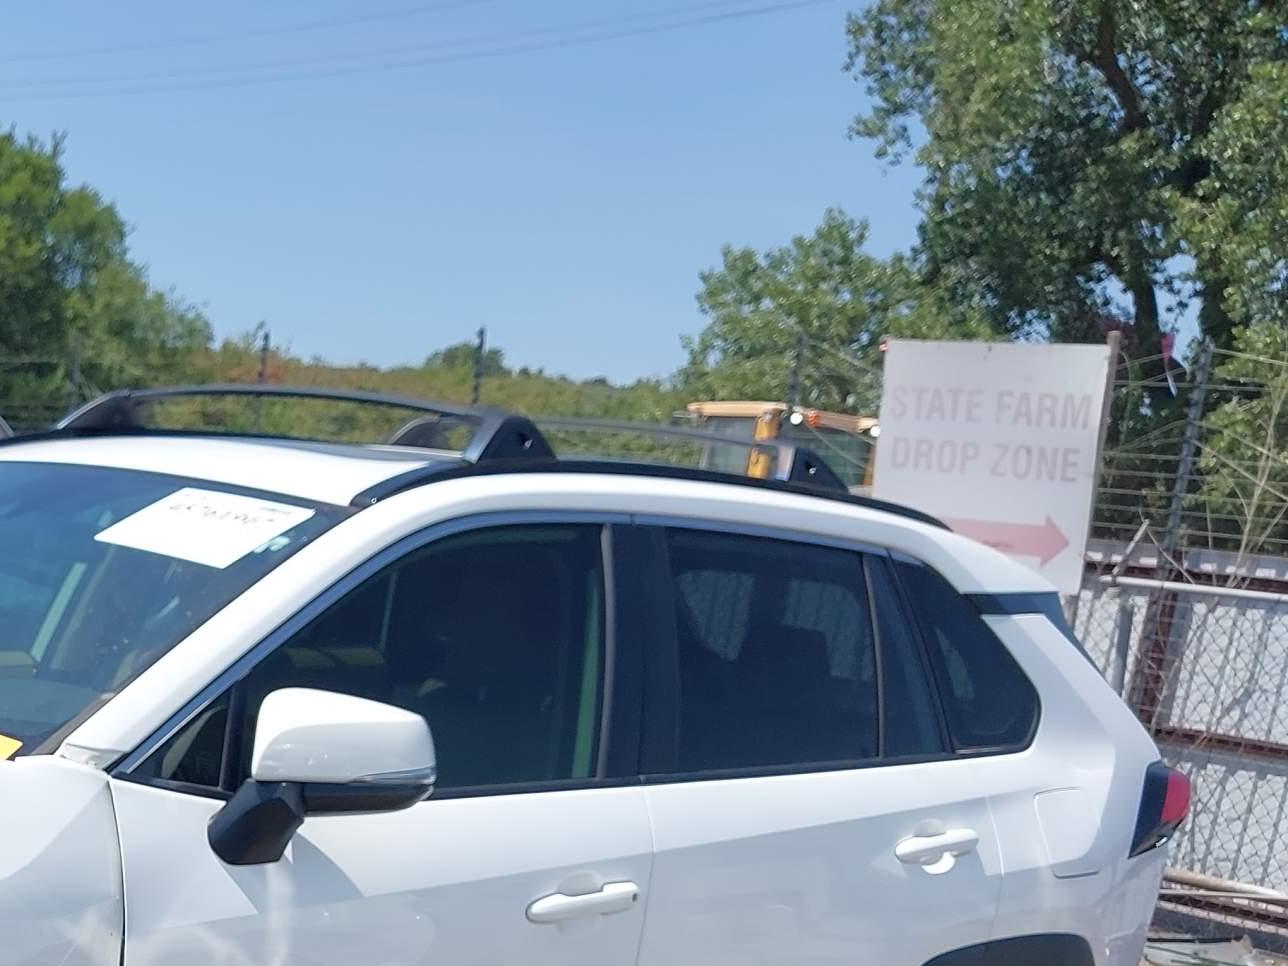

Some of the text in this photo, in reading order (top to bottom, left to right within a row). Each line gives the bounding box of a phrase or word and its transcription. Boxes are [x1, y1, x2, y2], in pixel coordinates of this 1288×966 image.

[891, 384, 1092, 430] STATE FARM
[890, 436, 1081, 482] DROP ZONE
